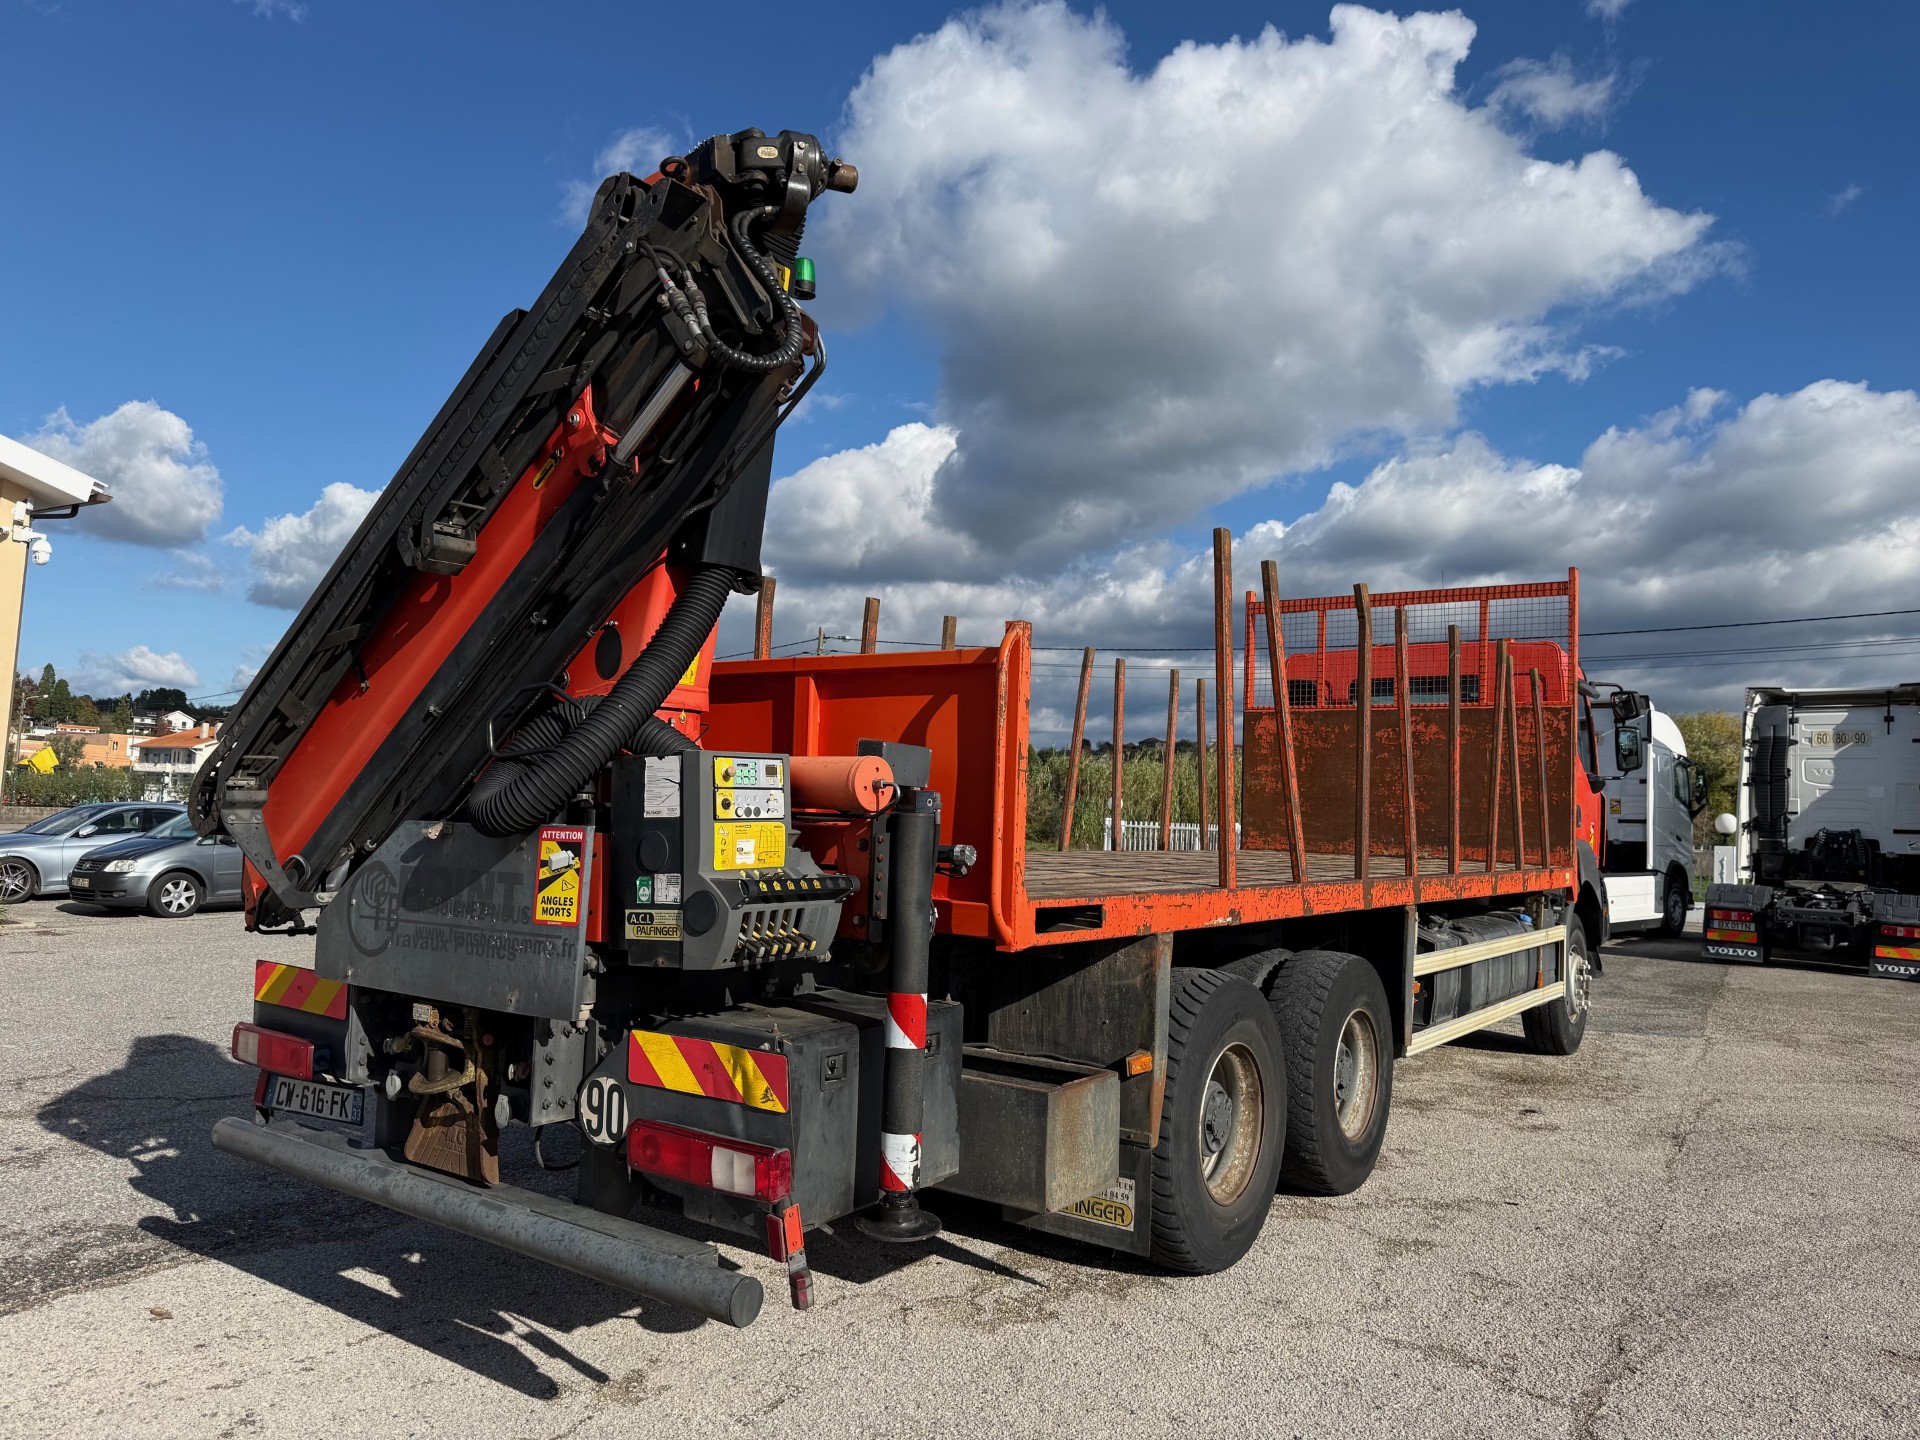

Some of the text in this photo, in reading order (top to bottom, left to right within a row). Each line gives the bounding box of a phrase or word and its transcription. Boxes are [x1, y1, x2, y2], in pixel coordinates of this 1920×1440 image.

[1816, 732, 1866, 744] 60 80 90
[542, 830, 583, 840] ATTENTION
[540, 895, 574, 906] ANGLES
[541, 906, 572, 918] MORTS
[636, 926, 678, 936] PALFINGER
[1706, 945, 1758, 957] VOLVO
[1874, 963, 1920, 975] VOLV
[352, 1107, 361, 1121] 33
[585, 1079, 625, 1141] 90
[1073, 1199, 1125, 1224] INGER
